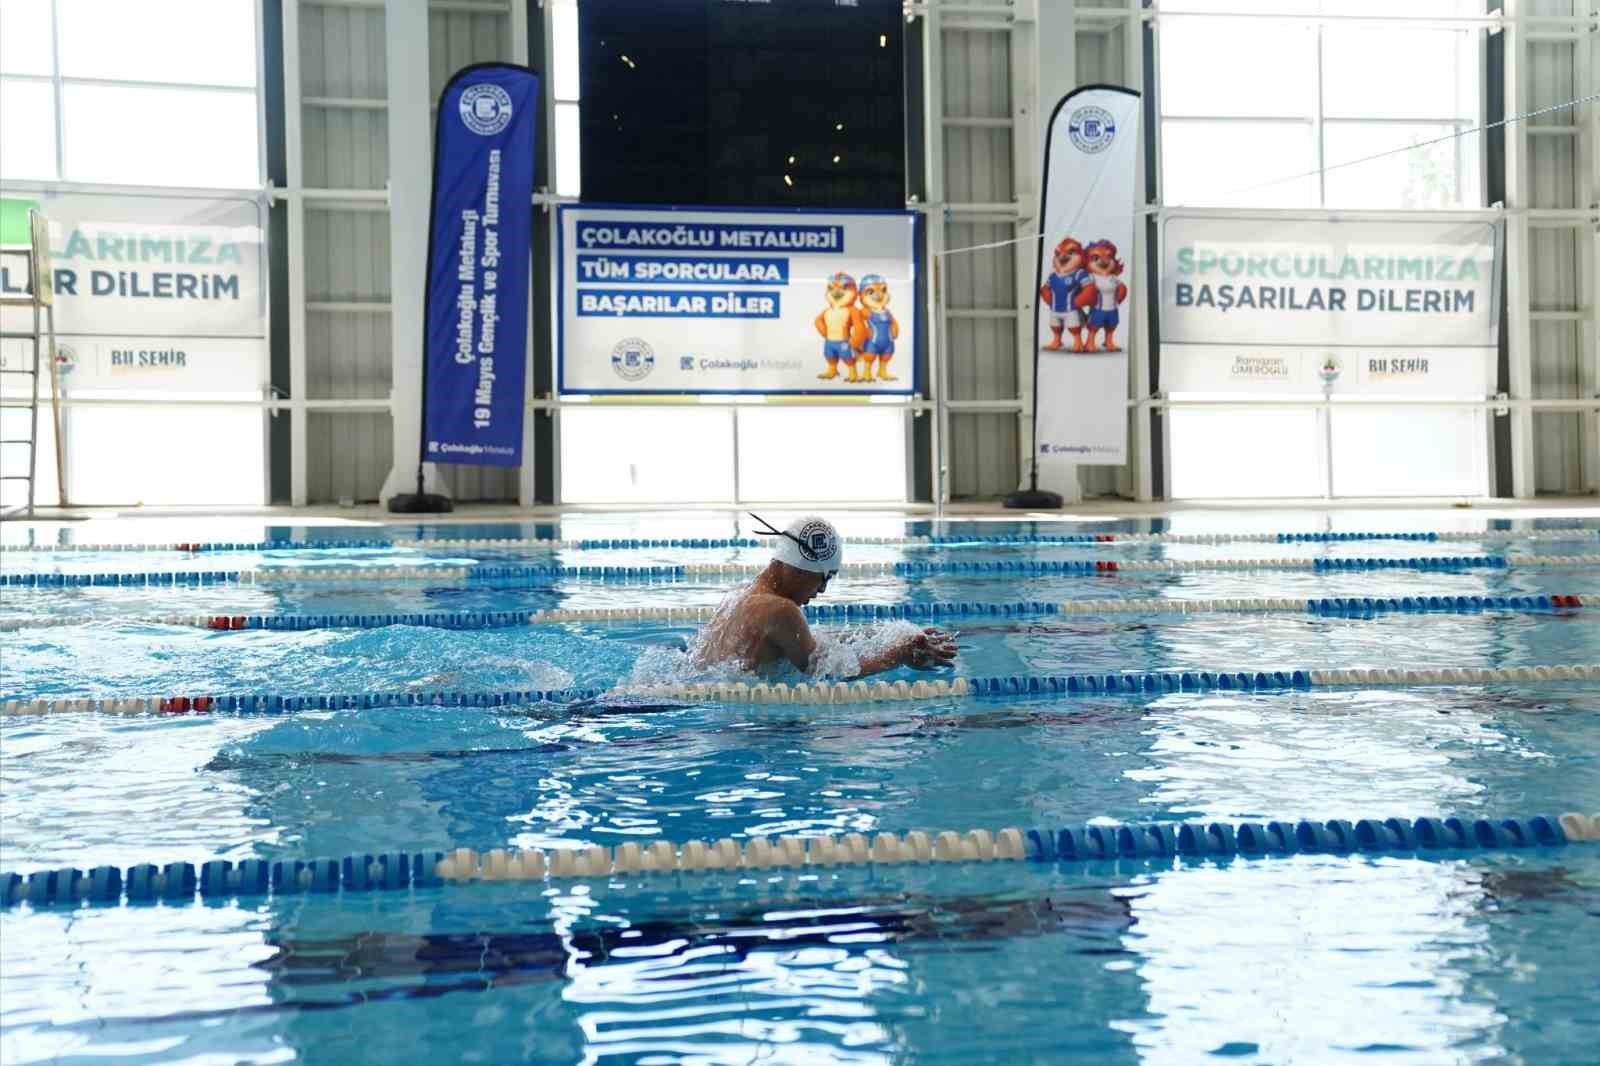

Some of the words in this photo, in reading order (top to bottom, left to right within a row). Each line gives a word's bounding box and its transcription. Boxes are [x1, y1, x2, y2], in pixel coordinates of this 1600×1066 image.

[481, 228, 501, 267] Spor
[582, 225, 715, 248] ÇOLAKOĞLU
[1, 267, 78, 295] LR
[483, 271, 497, 290] ve
[581, 256, 629, 279] TÜM
[635, 260, 781, 281] SPORCULARA
[581, 293, 707, 316] BAŞARILAR
[1176, 284, 1346, 313] BAŞARILAR
[478, 294, 500, 354] Gençlik
[475, 357, 496, 405] Mayıs
[473, 407, 491, 429] 19
